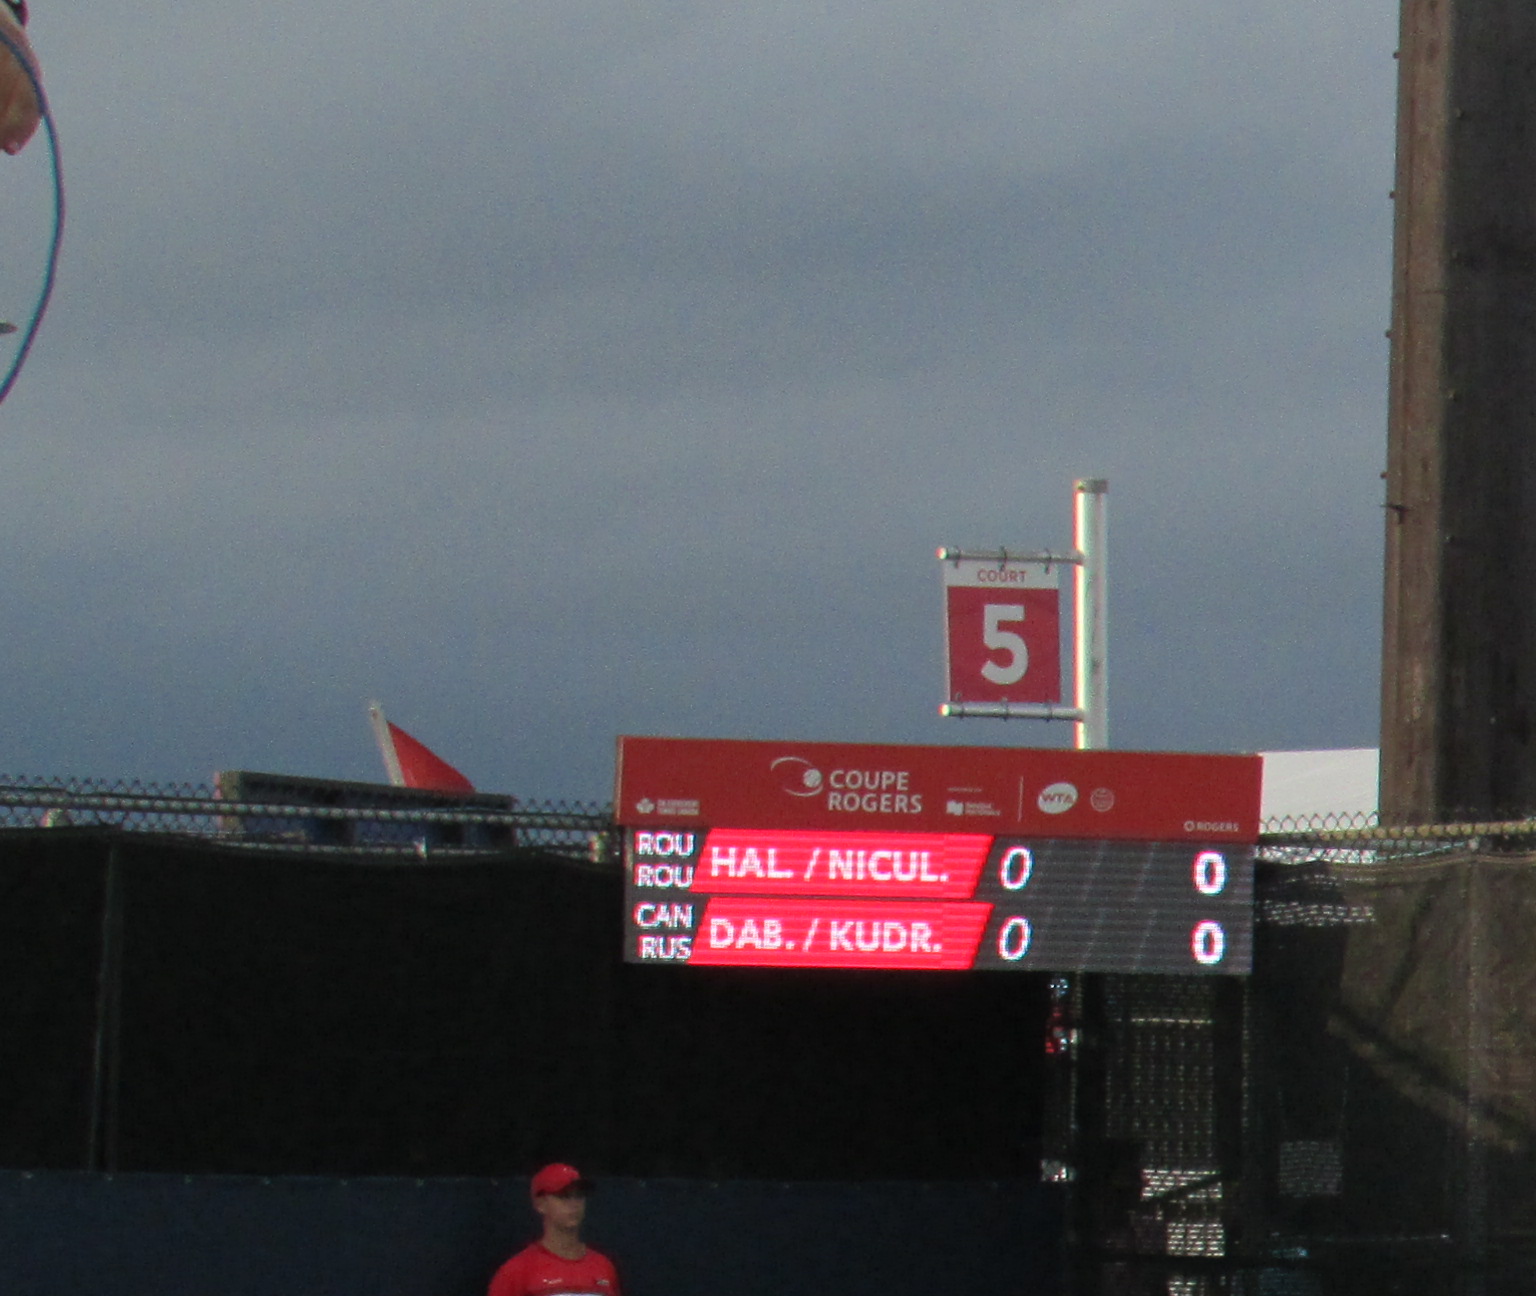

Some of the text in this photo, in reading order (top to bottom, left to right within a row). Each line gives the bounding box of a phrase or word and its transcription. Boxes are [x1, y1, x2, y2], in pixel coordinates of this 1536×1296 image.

[977, 568, 1027, 582] COURT
[980, 603, 1029, 685] 5
[829, 769, 910, 791] COUPE
[827, 791, 923, 814] ROGERS
[635, 832, 694, 857] ROU
[634, 863, 694, 888] ROU
[829, 850, 949, 882] NICUL.
[1000, 846, 1033, 891] 0
[1192, 851, 1227, 895] 0
[634, 902, 693, 929] CAN
[639, 935, 692, 960] RUS
[709, 918, 795, 949] DAB.
[829, 921, 943, 952] KUDR.
[999, 916, 1032, 961] 0
[1191, 920, 1225, 965] 0
